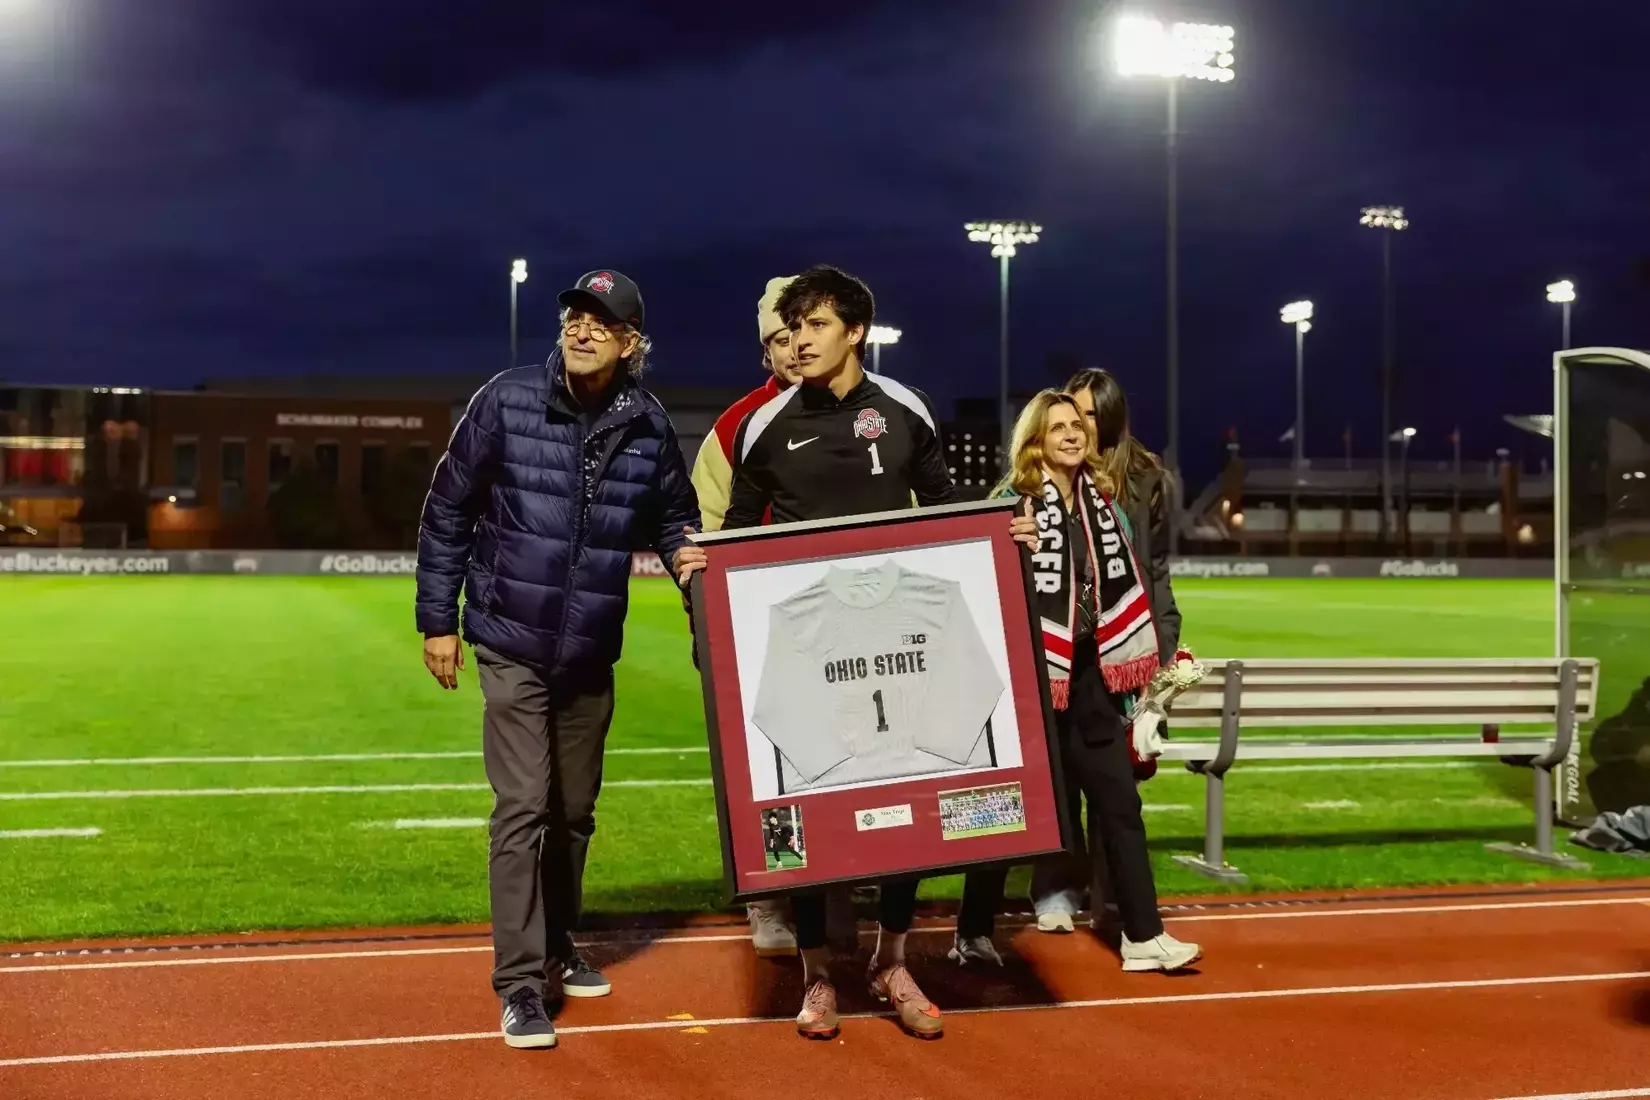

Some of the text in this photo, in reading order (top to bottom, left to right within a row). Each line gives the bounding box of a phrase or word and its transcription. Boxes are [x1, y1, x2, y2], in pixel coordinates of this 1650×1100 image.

[868, 442, 884, 475] 1
[0, 552, 169, 576] eBuckeyes.com
[824, 650, 927, 684] OHIO STATE
[873, 689, 889, 732] 1
